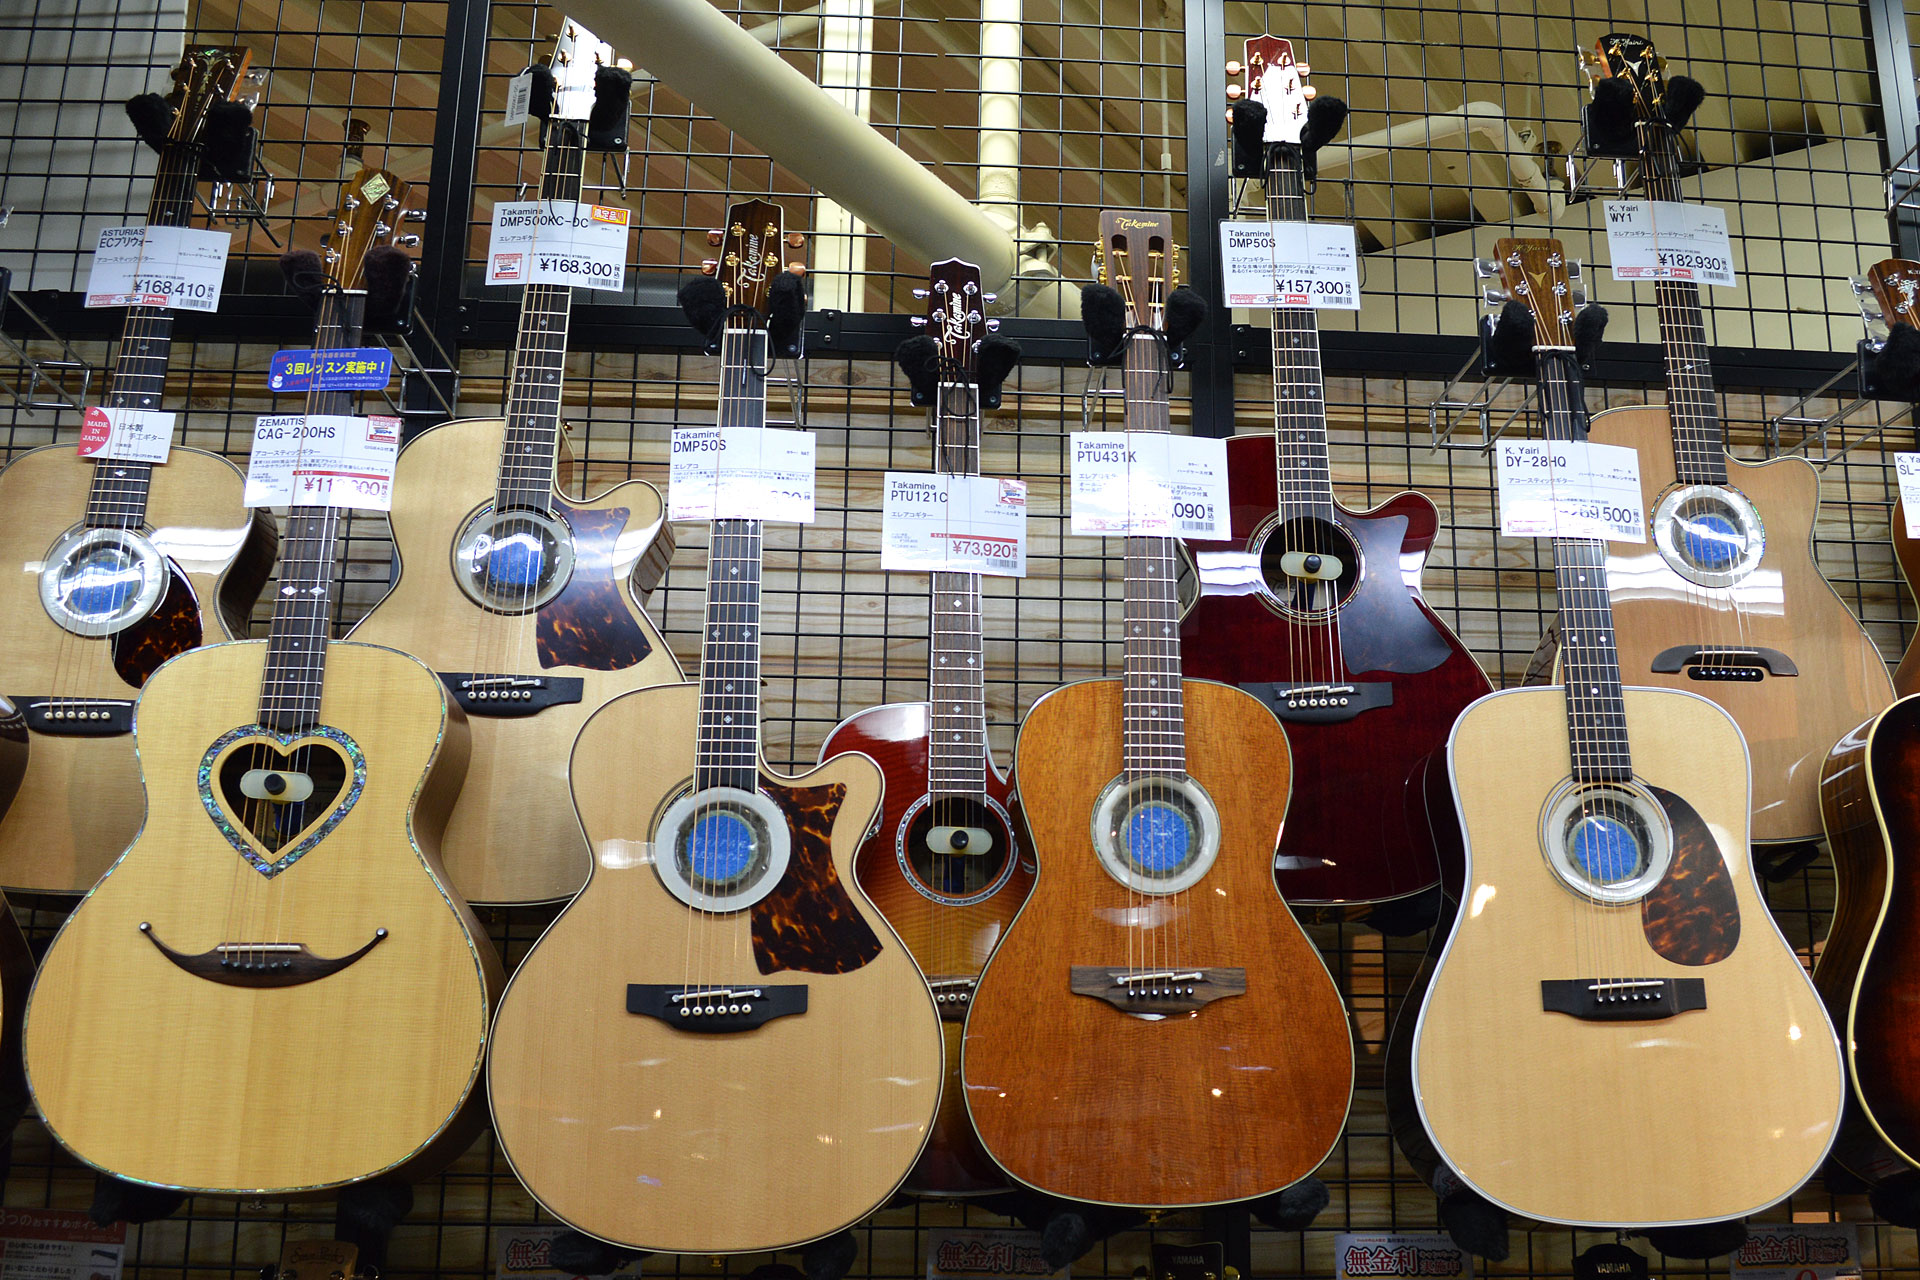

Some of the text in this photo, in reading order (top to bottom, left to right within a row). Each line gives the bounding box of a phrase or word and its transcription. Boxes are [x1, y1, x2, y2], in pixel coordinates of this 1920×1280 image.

[1116, 217, 1159, 230] Takamine
[1610, 213, 1632, 222] WY1
[102, 228, 144, 236] ASTURIAS
[99, 238, 152, 248] ECプリウォー
[1229, 238, 1276, 248] DMP50S
[540, 258, 612, 277] ¥168,300
[1658, 253, 1720, 270] ¥182,930
[134, 280, 206, 298] ¥168,410
[1276, 280, 1344, 294] ¥157,300
[119, 423, 144, 432] 日本製
[259, 418, 304, 426] ZEMAITIS
[130, 432, 165, 441] 手工ギター
[257, 427, 336, 440] CAG-200HS
[674, 431, 720, 440] Takamine
[674, 440, 726, 452] DMP50S
[1078, 442, 1124, 450] Takamine
[1077, 451, 1136, 462] PTU431K
[1506, 456, 1566, 468] DY-28HQ
[892, 481, 936, 490] Takamine
[892, 490, 948, 502] PTU121C
[952, 540, 1011, 558] ¥73,920
[1740, 1236, 1806, 1266] 無金利
[939, 1242, 1014, 1273] 無金利
[1172, 1256, 1204, 1264] YAMAHA
[1346, 1246, 1418, 1275] 無金利
[1421, 1260, 1460, 1274] 実施中
[1594, 1263, 1632, 1274] YAMAHA
